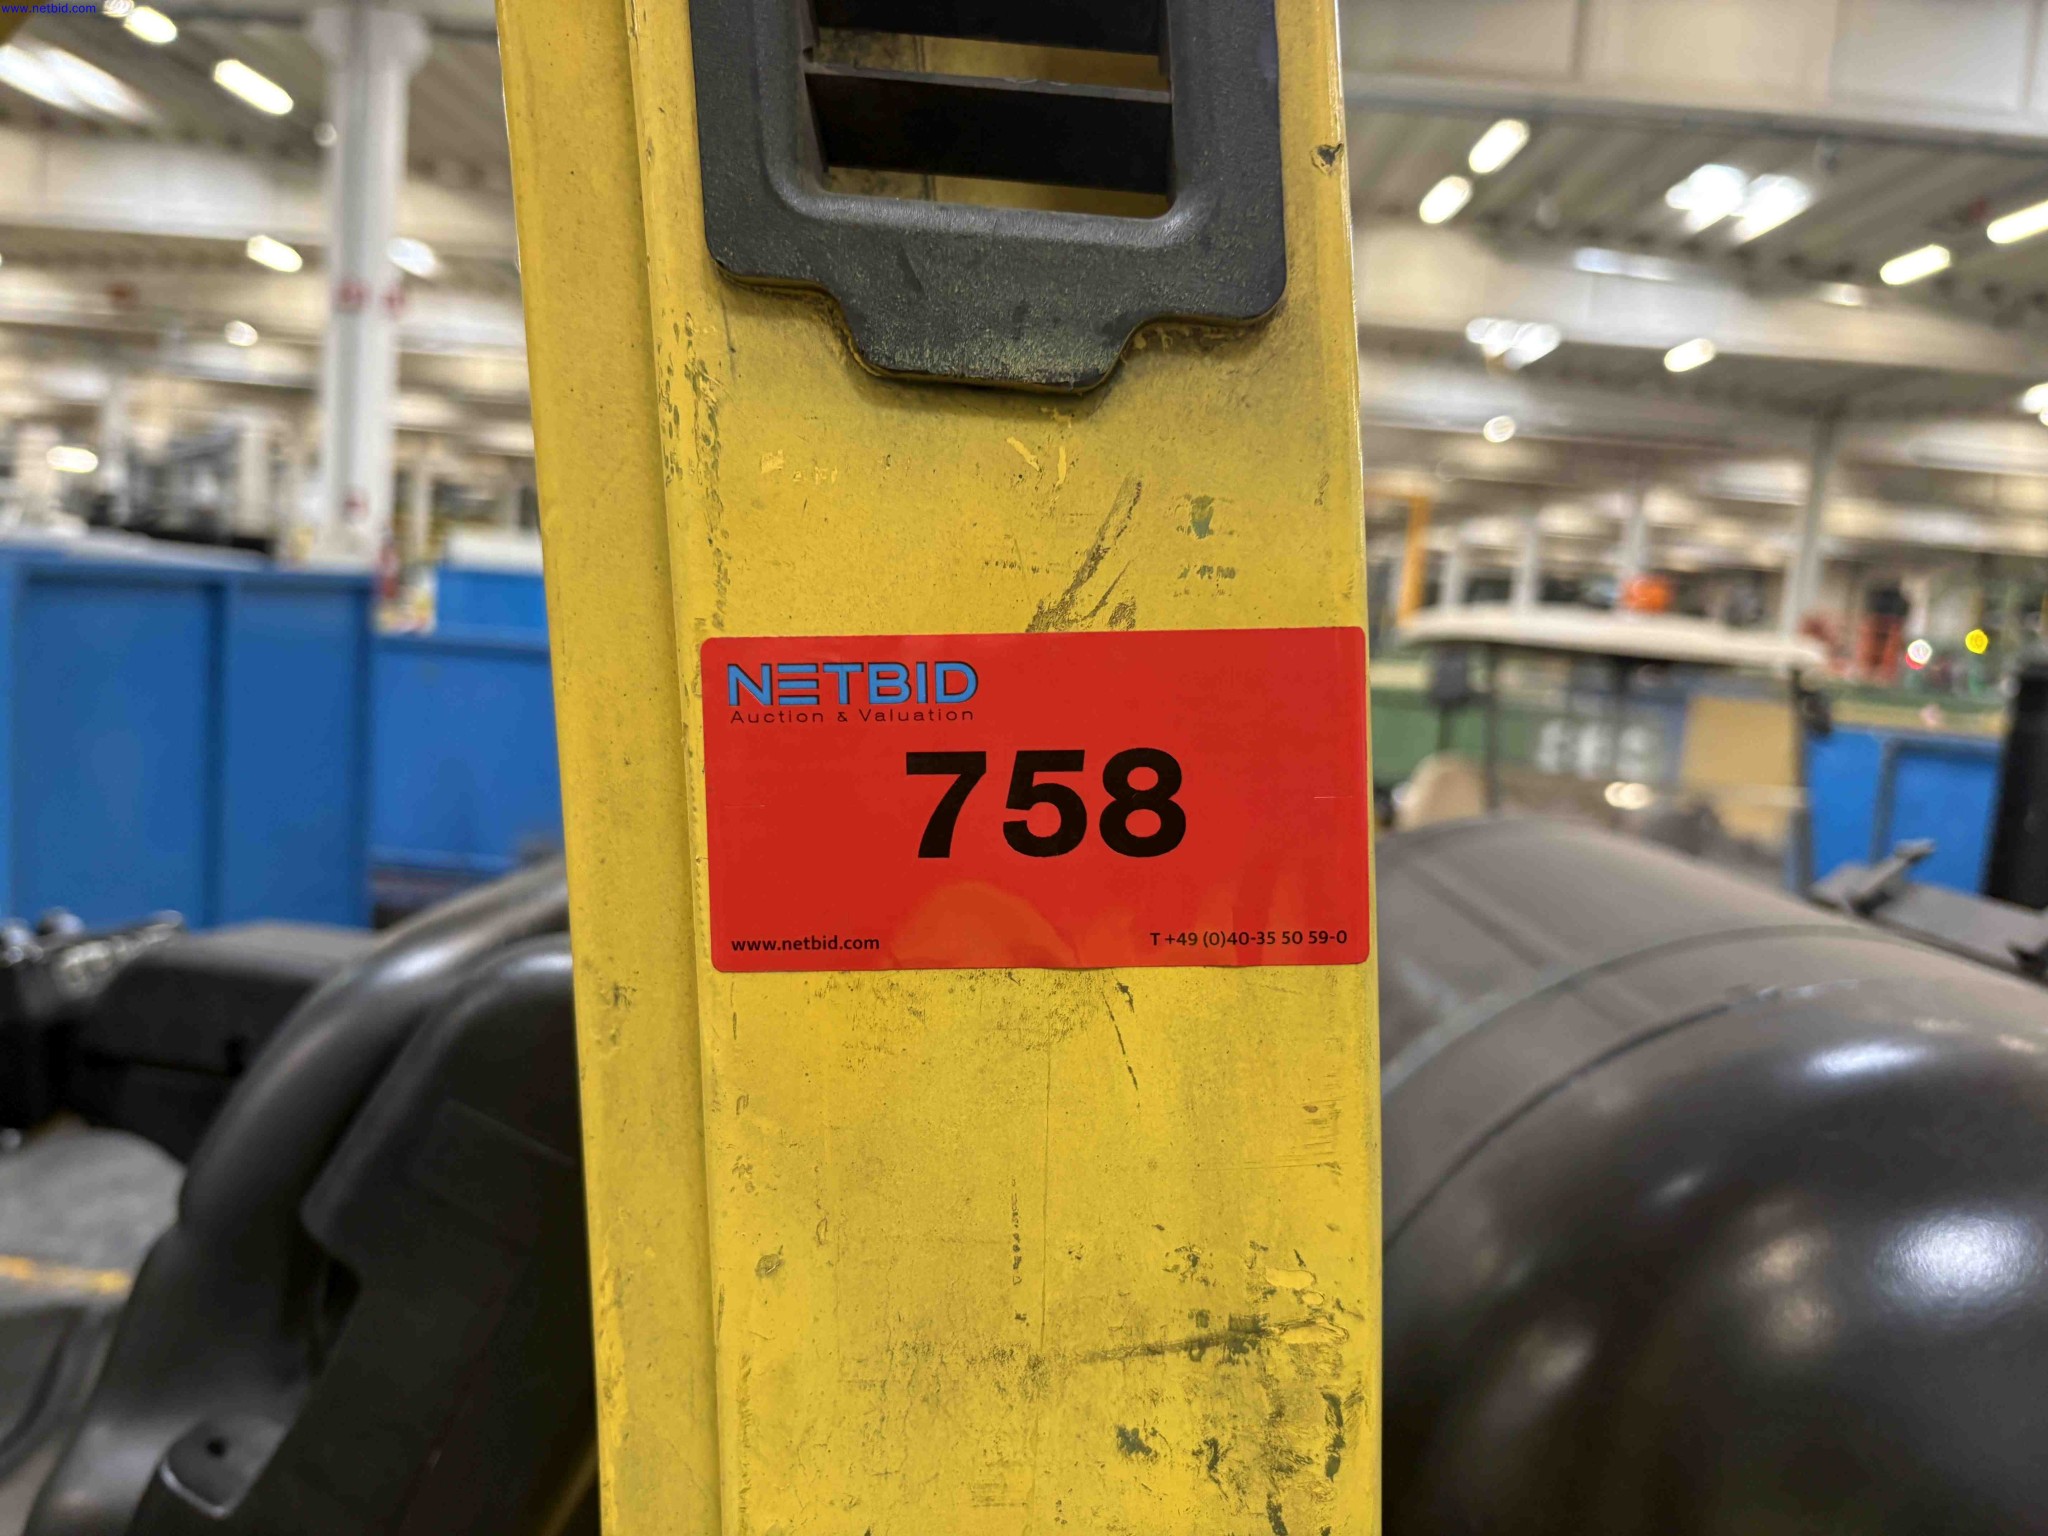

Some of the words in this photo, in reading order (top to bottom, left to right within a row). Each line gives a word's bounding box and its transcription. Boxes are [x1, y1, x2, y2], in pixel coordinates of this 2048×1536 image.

[727, 661, 979, 706] NETBID
[731, 710, 824, 724] Auction
[837, 710, 848, 723] &
[859, 708, 974, 722] Valuation
[905, 747, 1187, 859] 758
[731, 935, 880, 951] www.netbid.com
[1151, 932, 1161, 946] T
[1164, 931, 1198, 946] +49
[1203, 931, 1276, 948] (0)40-35
[1282, 931, 1304, 945] 50
[1308, 930, 1348, 944] 59-0
